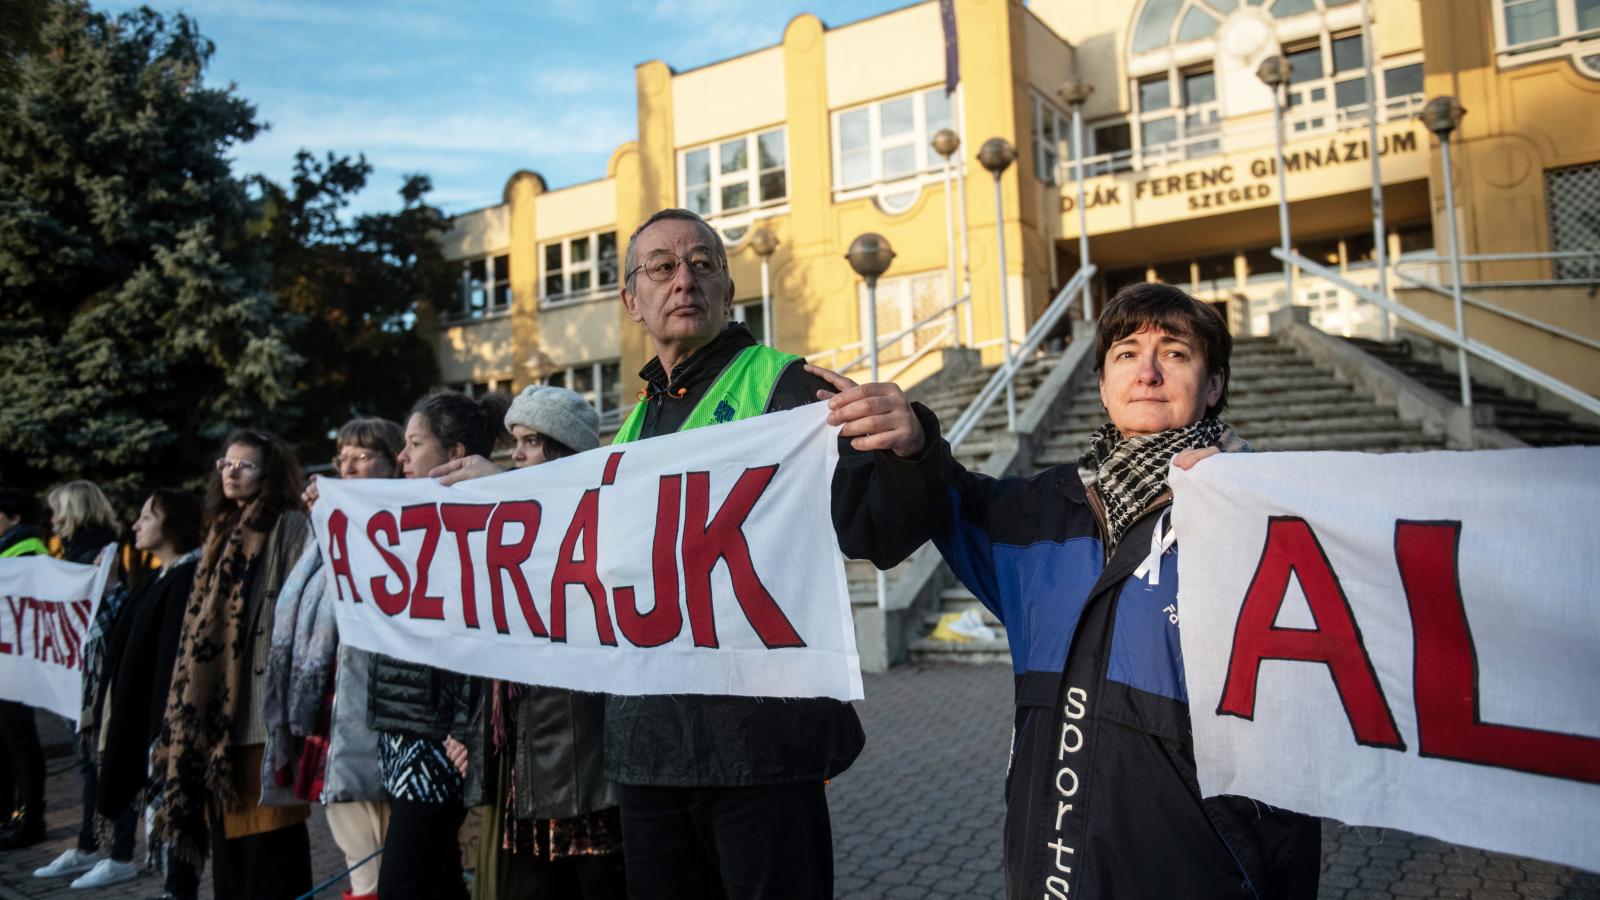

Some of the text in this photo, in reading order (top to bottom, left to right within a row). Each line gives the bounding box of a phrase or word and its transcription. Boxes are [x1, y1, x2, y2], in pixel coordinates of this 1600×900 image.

[1136, 165, 1233, 200] FERENC
[1251, 131, 1417, 178] GIMNÁZIUM
[1188, 184, 1271, 210] SZEGED
[328, 451, 807, 649] A SZTRÁJK
[1215, 515, 1600, 785] AL
